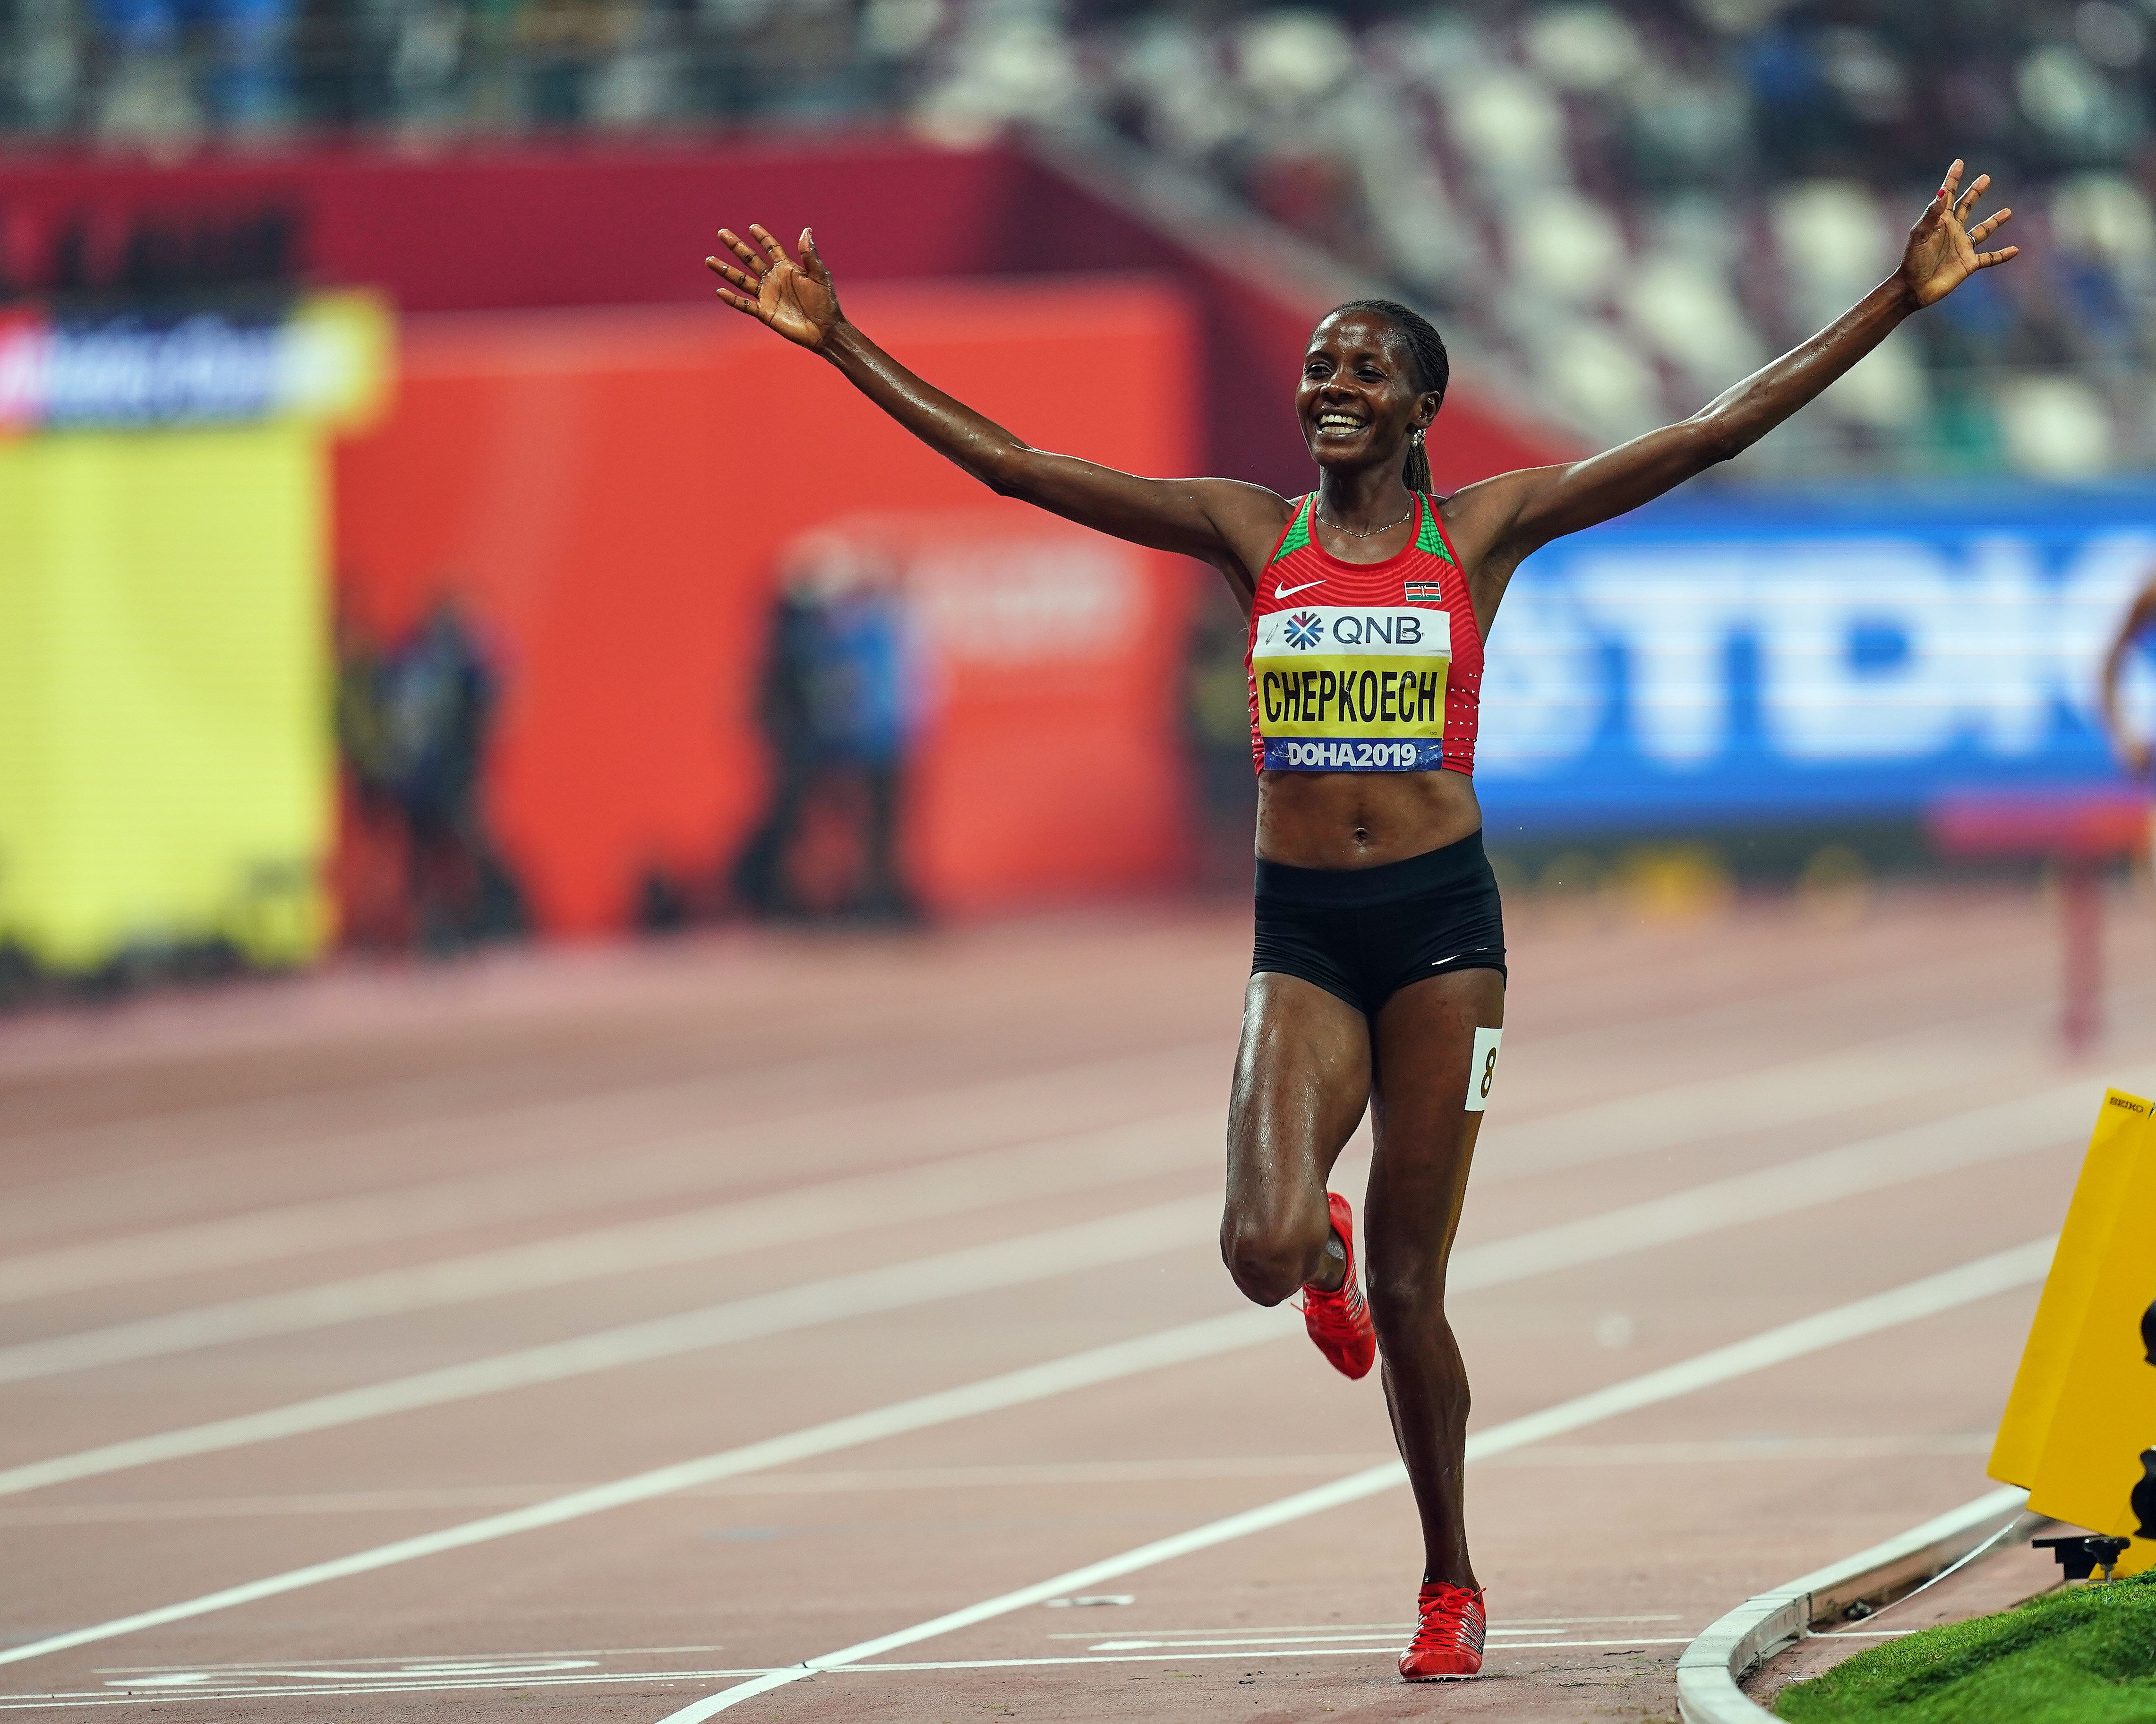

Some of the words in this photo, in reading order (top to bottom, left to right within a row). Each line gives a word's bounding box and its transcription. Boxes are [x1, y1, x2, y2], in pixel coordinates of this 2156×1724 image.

[1333, 616, 1421, 645] QNB
[1263, 670, 1437, 723] CHEPKOECH
[1288, 742, 1417, 767] DOHA2019
[1480, 1046, 1497, 1098] 8
[2110, 1097, 2144, 1113] SEIKO
